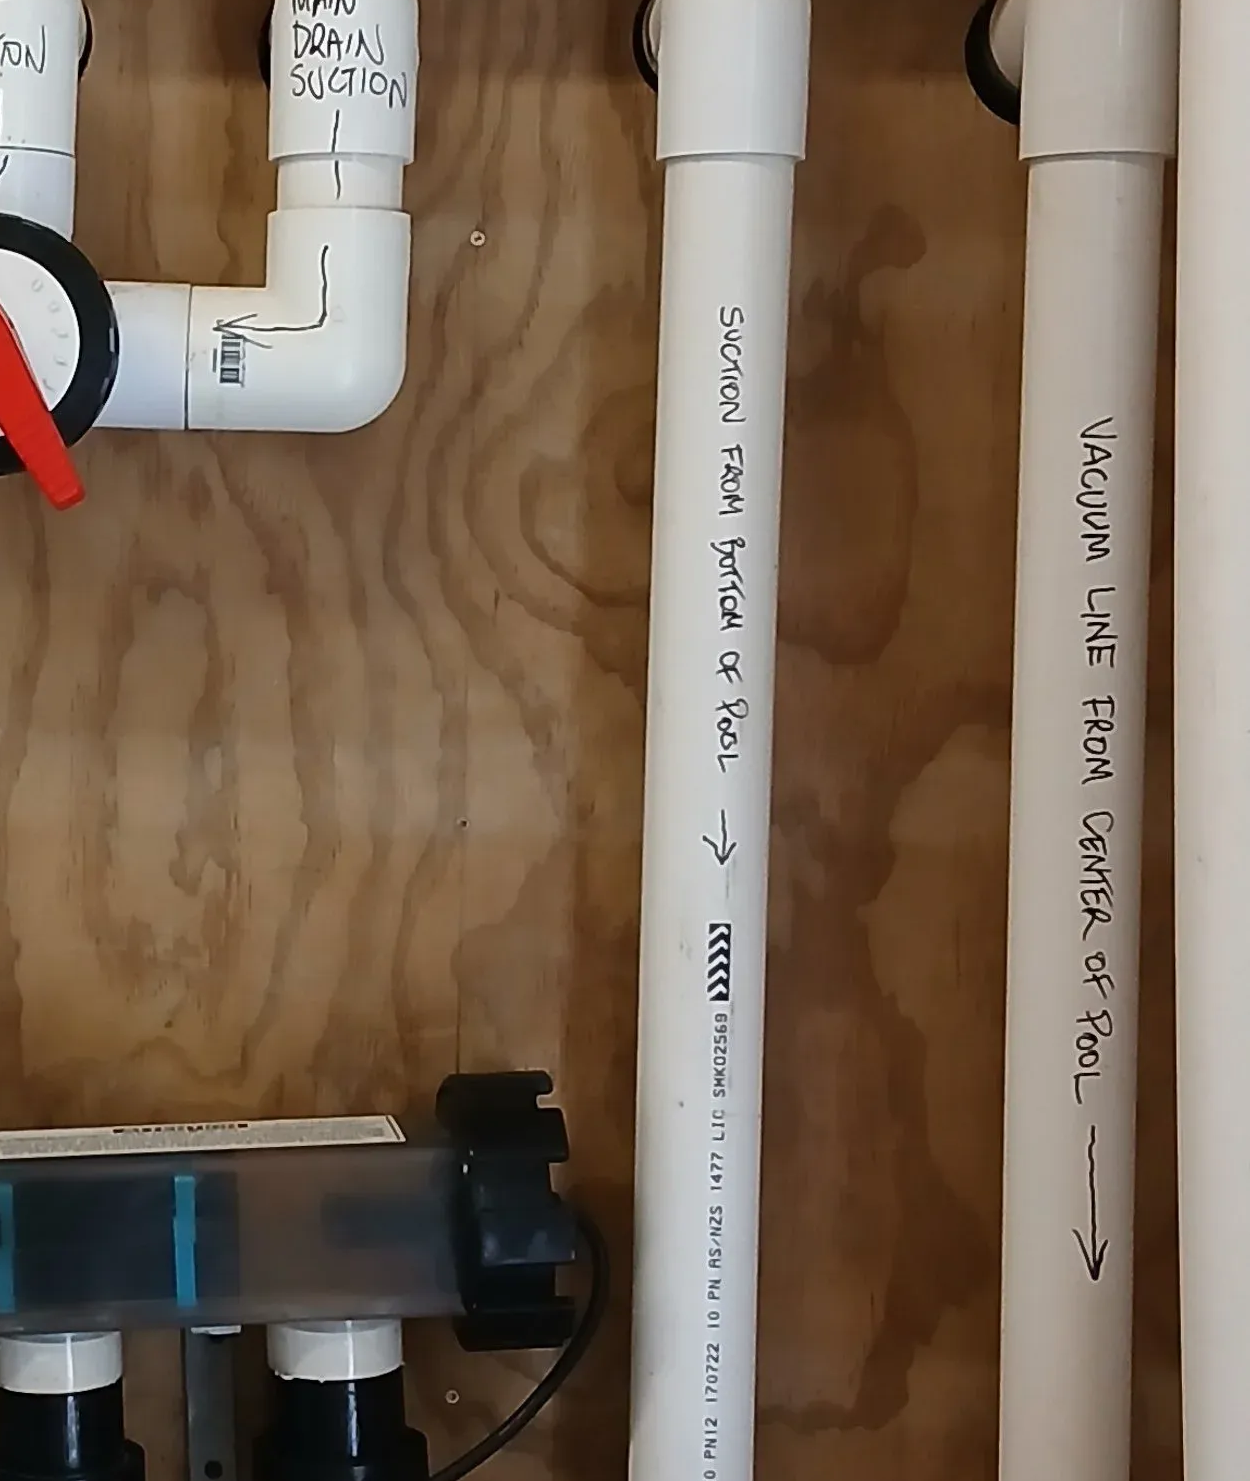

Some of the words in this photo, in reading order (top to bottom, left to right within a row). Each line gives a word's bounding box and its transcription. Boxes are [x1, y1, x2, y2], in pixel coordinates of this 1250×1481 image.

[292, 20, 385, 65] DRAIN
[290, 63, 407, 108] SUCTION
[719, 306, 747, 423] SUCTION
[718, 444, 745, 515] FROM
[1076, 416, 1118, 563] VACUUM
[710, 536, 747, 632] BOTTOM
[1080, 586, 1118, 669] LINE
[716, 651, 743, 684] OF
[715, 698, 749, 773] POOL
[1082, 695, 1115, 785] FROM
[1078, 810, 1114, 942] CENTER
[1082, 951, 1115, 1000] OF
[1073, 1009, 1113, 1105] POOL
[711, 1109, 725, 1142] LIC
[710, 1151, 724, 1191] 1477
[708, 1204, 723, 1269] AS/NZS
[707, 1278, 722, 1301] PN
[707, 1310, 720, 1329] 10
[704, 1342, 720, 1403] 170722
[703, 1417, 718, 1460] PN12
